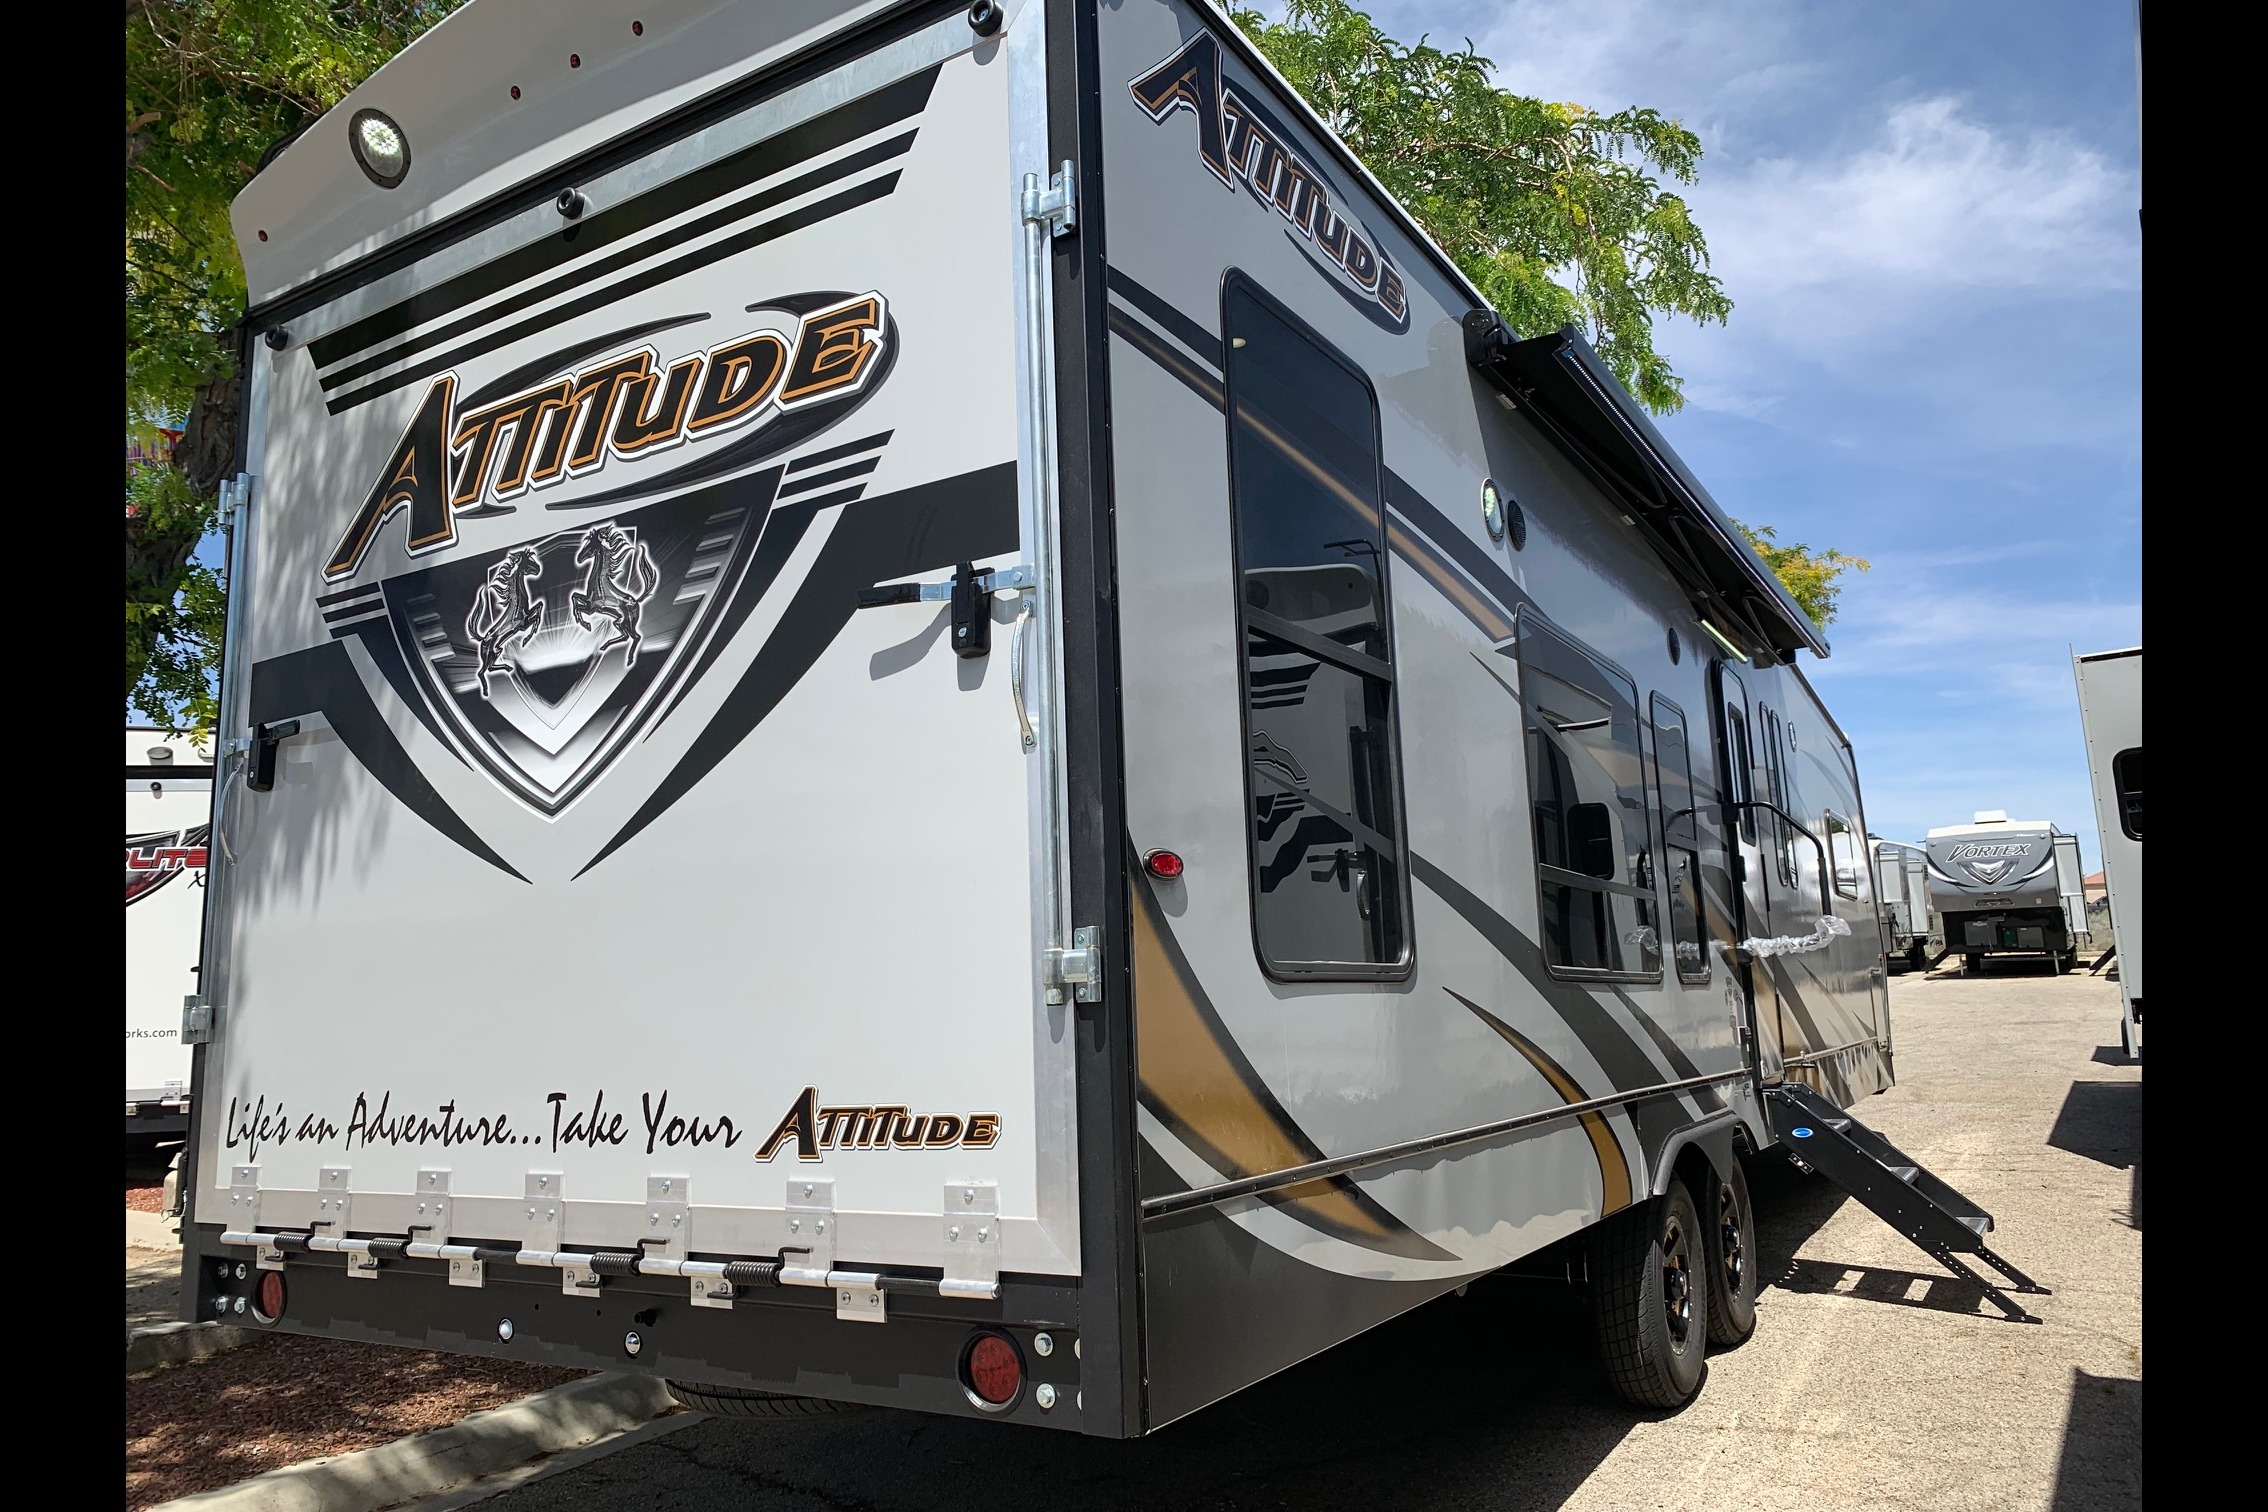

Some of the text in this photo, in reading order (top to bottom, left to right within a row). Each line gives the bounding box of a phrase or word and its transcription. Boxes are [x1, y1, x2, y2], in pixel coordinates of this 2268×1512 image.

[1127, 26, 1407, 324] ATTITUDE
[321, 289, 890, 584] ATTITUDE
[1945, 843, 2032, 863] VORTEX
[226, 1094, 292, 1163] Life's
[295, 1113, 340, 1144] an
[642, 1089, 743, 1155] Your
[753, 1085, 1001, 1162] ATTITUDE
